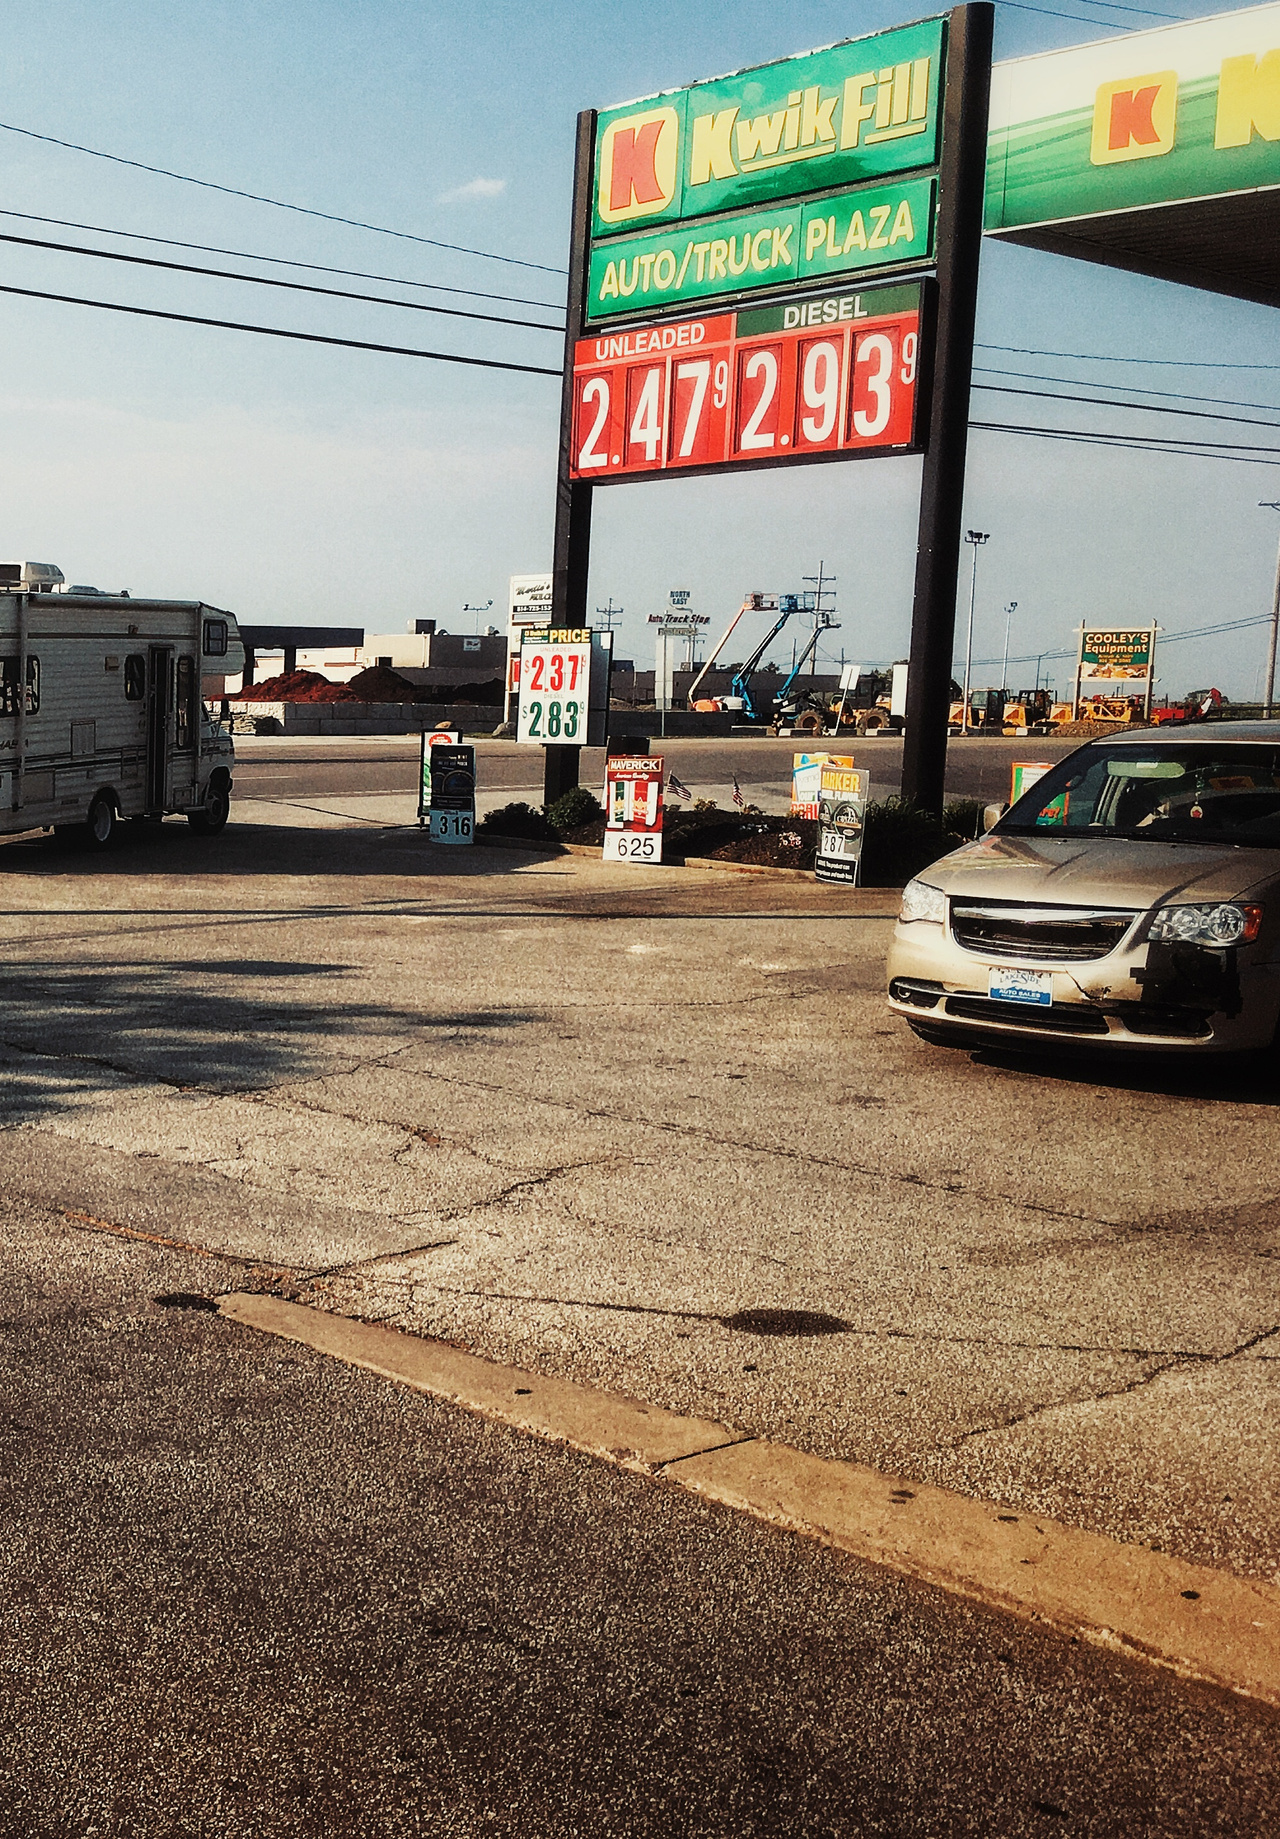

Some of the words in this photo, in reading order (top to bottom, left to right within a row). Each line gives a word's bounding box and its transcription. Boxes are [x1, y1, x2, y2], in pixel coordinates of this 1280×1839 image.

[1108, 85, 1162, 150] K
[609, 119, 666, 212] K
[599, 223, 794, 301] AUTO/TRUCK
[805, 199, 915, 261] PLAZA
[783, 295, 868, 330] DIESEL
[595, 322, 706, 361] UNLEADED
[669, 590, 691, 598] NORTH
[690, 614, 711, 625] Stop
[549, 629, 591, 643] PRICE
[1085, 633, 1149, 643] COOLEY'S
[1085, 643, 1148, 654] Equipment
[610, 760, 658, 770] MAVERICK
[618, 837, 655, 856] 625
